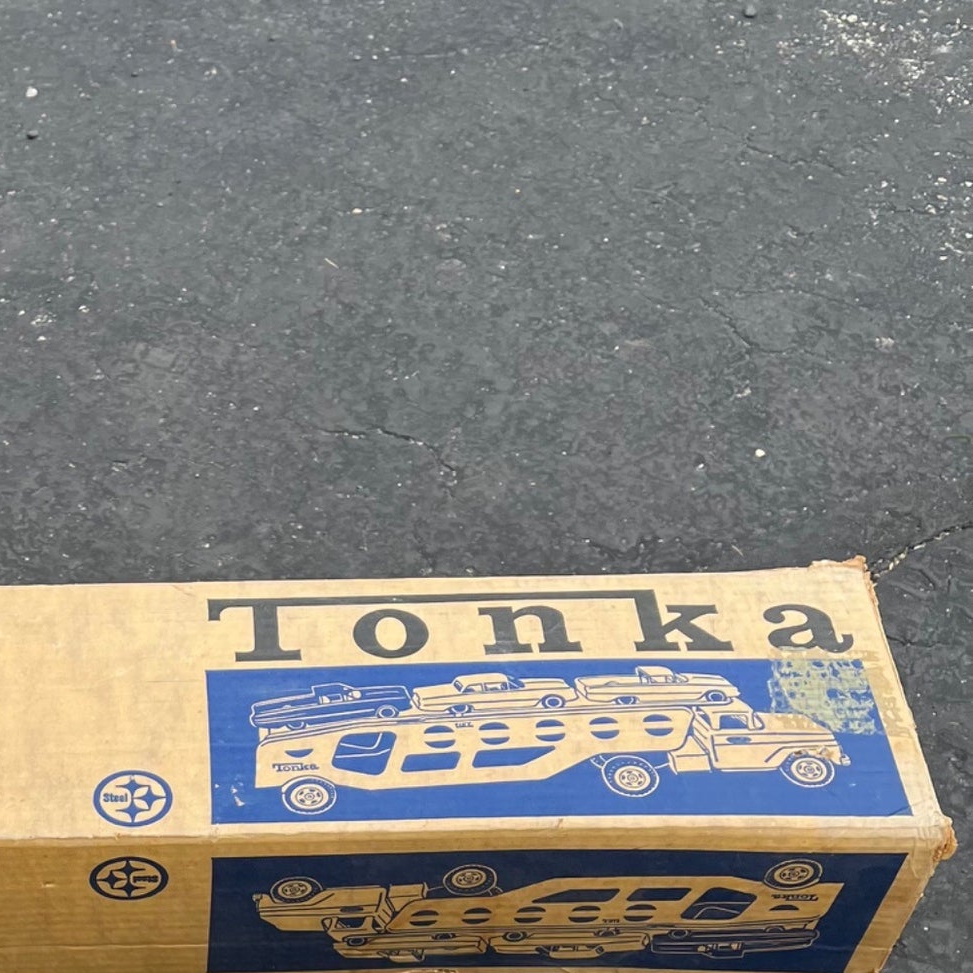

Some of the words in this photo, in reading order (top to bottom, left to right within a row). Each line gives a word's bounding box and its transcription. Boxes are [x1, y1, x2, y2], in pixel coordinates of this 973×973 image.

[208, 589, 854, 662] Tonka
[272, 763, 319, 772] Tonka
[103, 792, 128, 803] Steel
